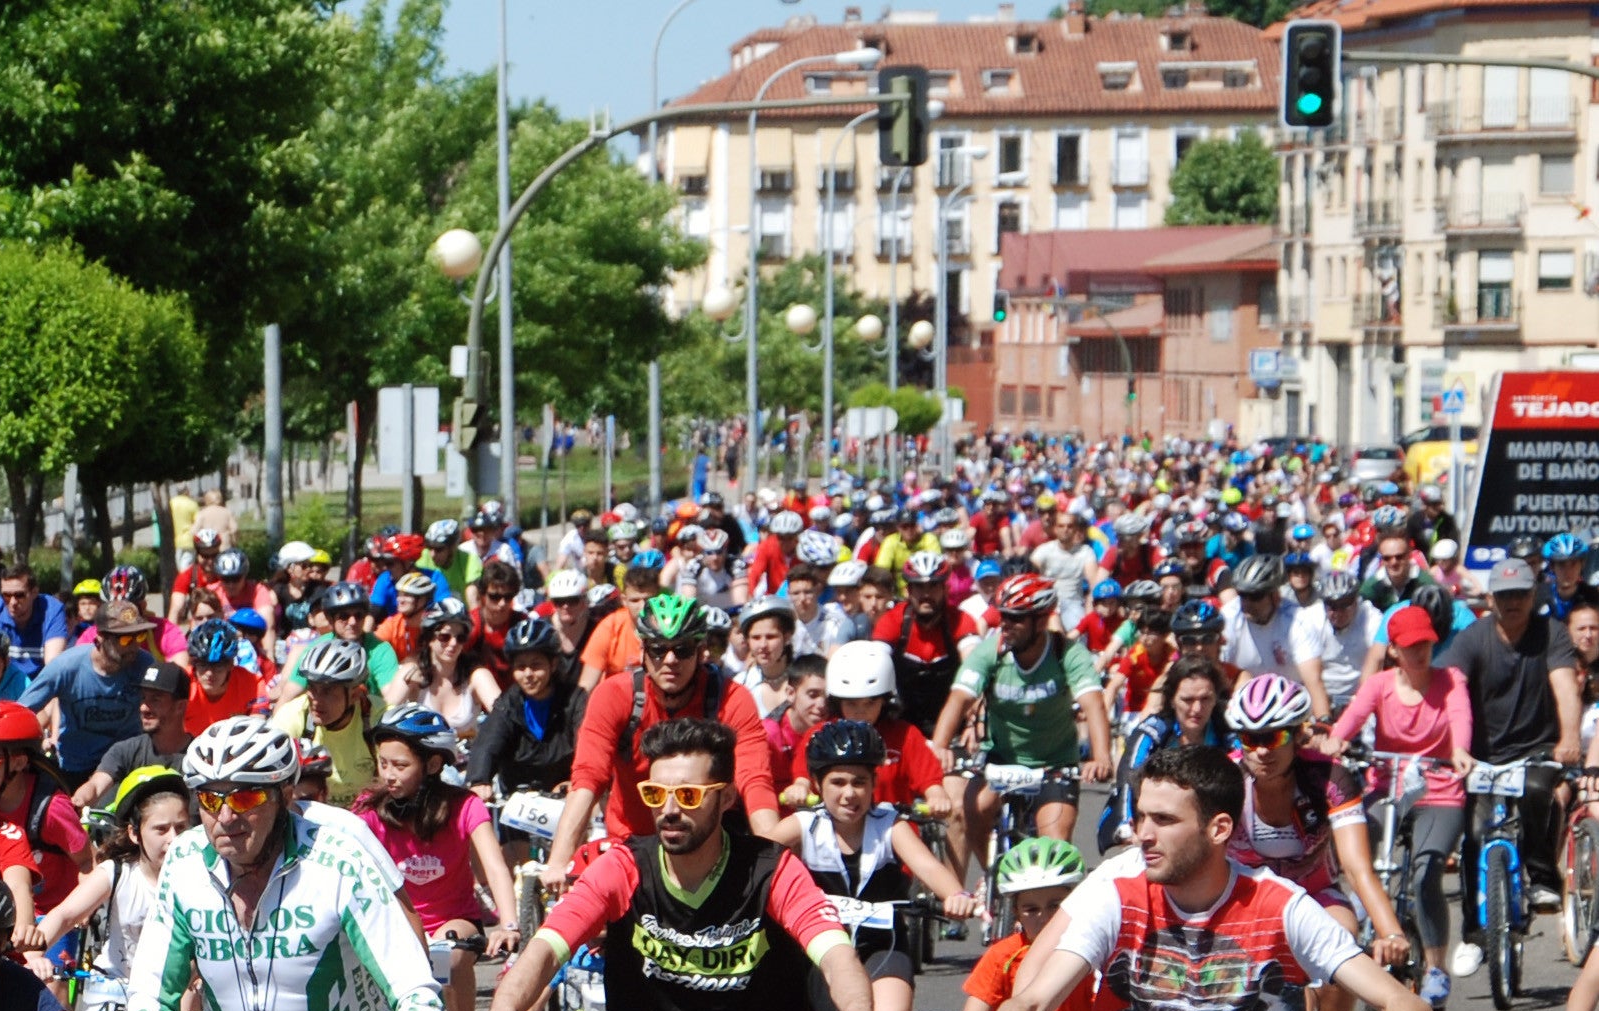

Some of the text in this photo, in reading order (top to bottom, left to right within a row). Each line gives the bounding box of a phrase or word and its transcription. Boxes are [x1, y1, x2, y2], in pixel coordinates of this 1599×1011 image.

[1507, 441, 1599, 459] MAMPARA
[1518, 459, 1599, 480] DE BAÑO
[1515, 493, 1599, 512] PUERTAS
[517, 803, 549, 825] 156
[184, 904, 316, 934] CICLOS
[194, 933, 321, 962] EBORA
